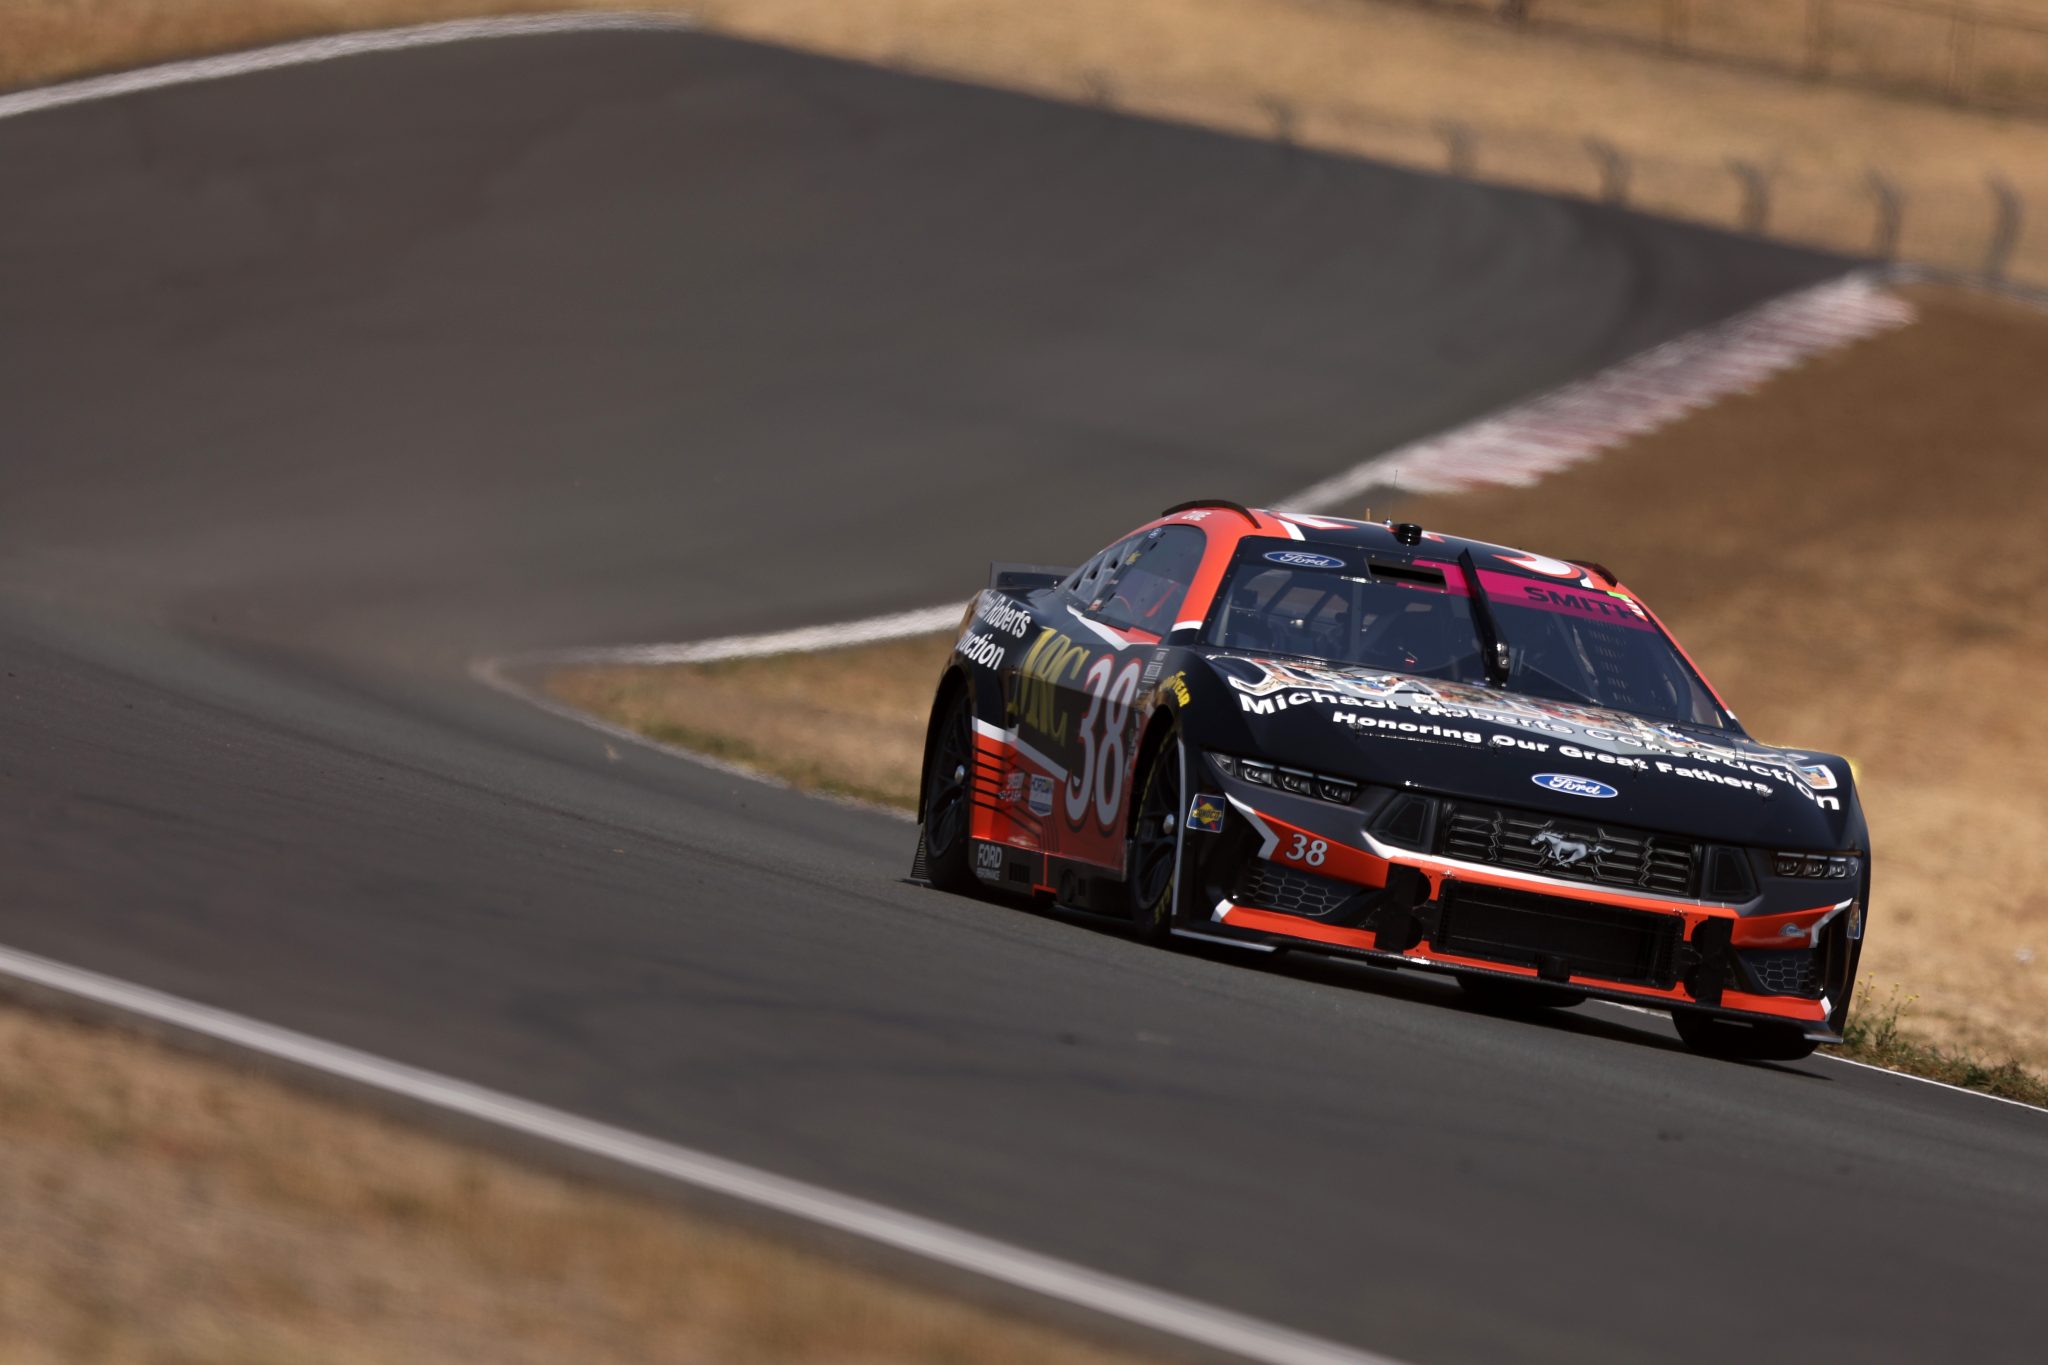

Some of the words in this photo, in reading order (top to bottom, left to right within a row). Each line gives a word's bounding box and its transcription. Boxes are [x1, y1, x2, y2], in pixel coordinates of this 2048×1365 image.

[985, 593, 1032, 638] Roberts
[1524, 586, 1645, 623] SMITH
[1065, 653, 1142, 833] 38
[1332, 711, 1482, 744] Honoring
[1491, 733, 1550, 753] Our
[1558, 745, 1650, 771] Great
[1655, 761, 1774, 796] Fathers
[977, 843, 1003, 869] FORD
[1285, 833, 1328, 867] 38
